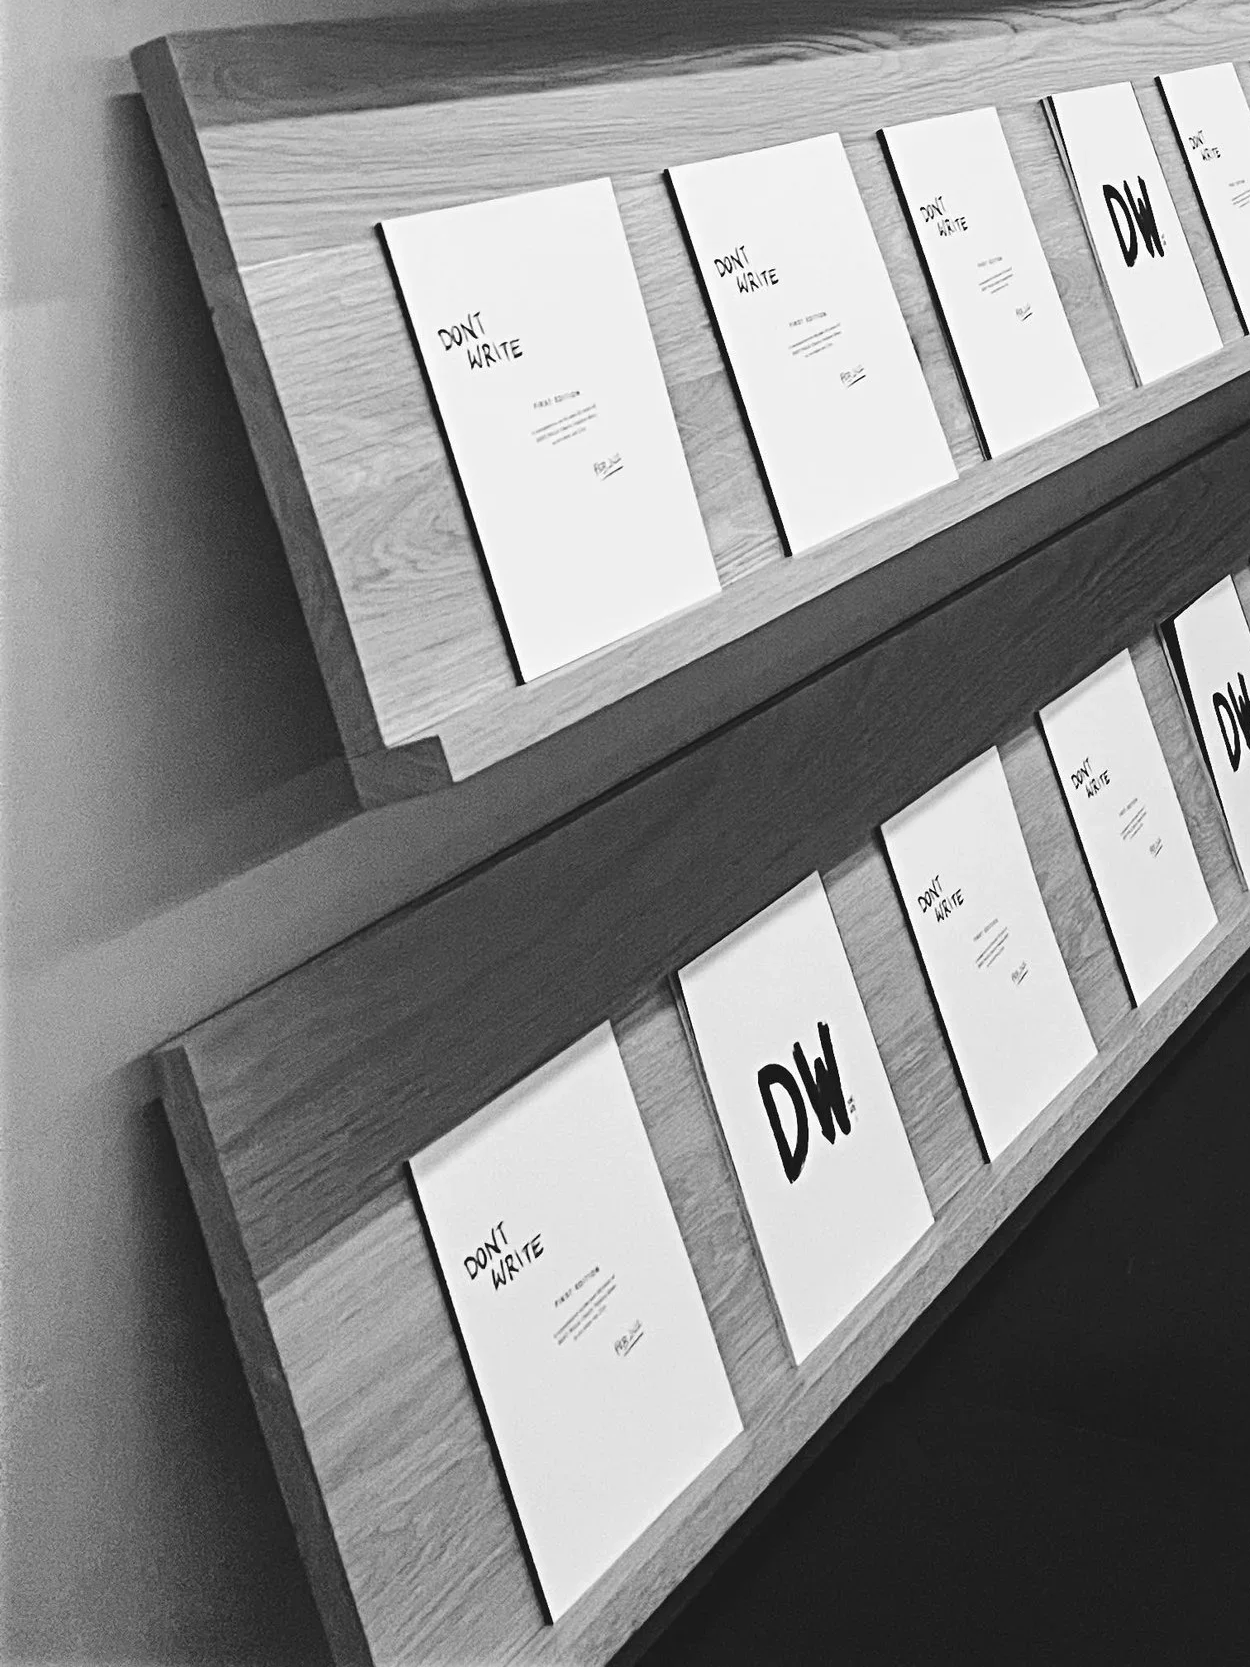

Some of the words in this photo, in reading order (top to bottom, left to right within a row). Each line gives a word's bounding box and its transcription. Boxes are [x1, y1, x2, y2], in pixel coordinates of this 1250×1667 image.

[1101, 174, 1165, 268] DW
[713, 244, 750, 278] DONT
[736, 268, 780, 294] WRITE
[437, 311, 486, 352] DONT
[466, 338, 524, 371] WRITE
[917, 874, 943, 914] DONT
[934, 888, 965, 923] WRITE
[757, 1021, 852, 1185] DW
[462, 1220, 508, 1281] DONT
[491, 1233, 544, 1291] WRITE
